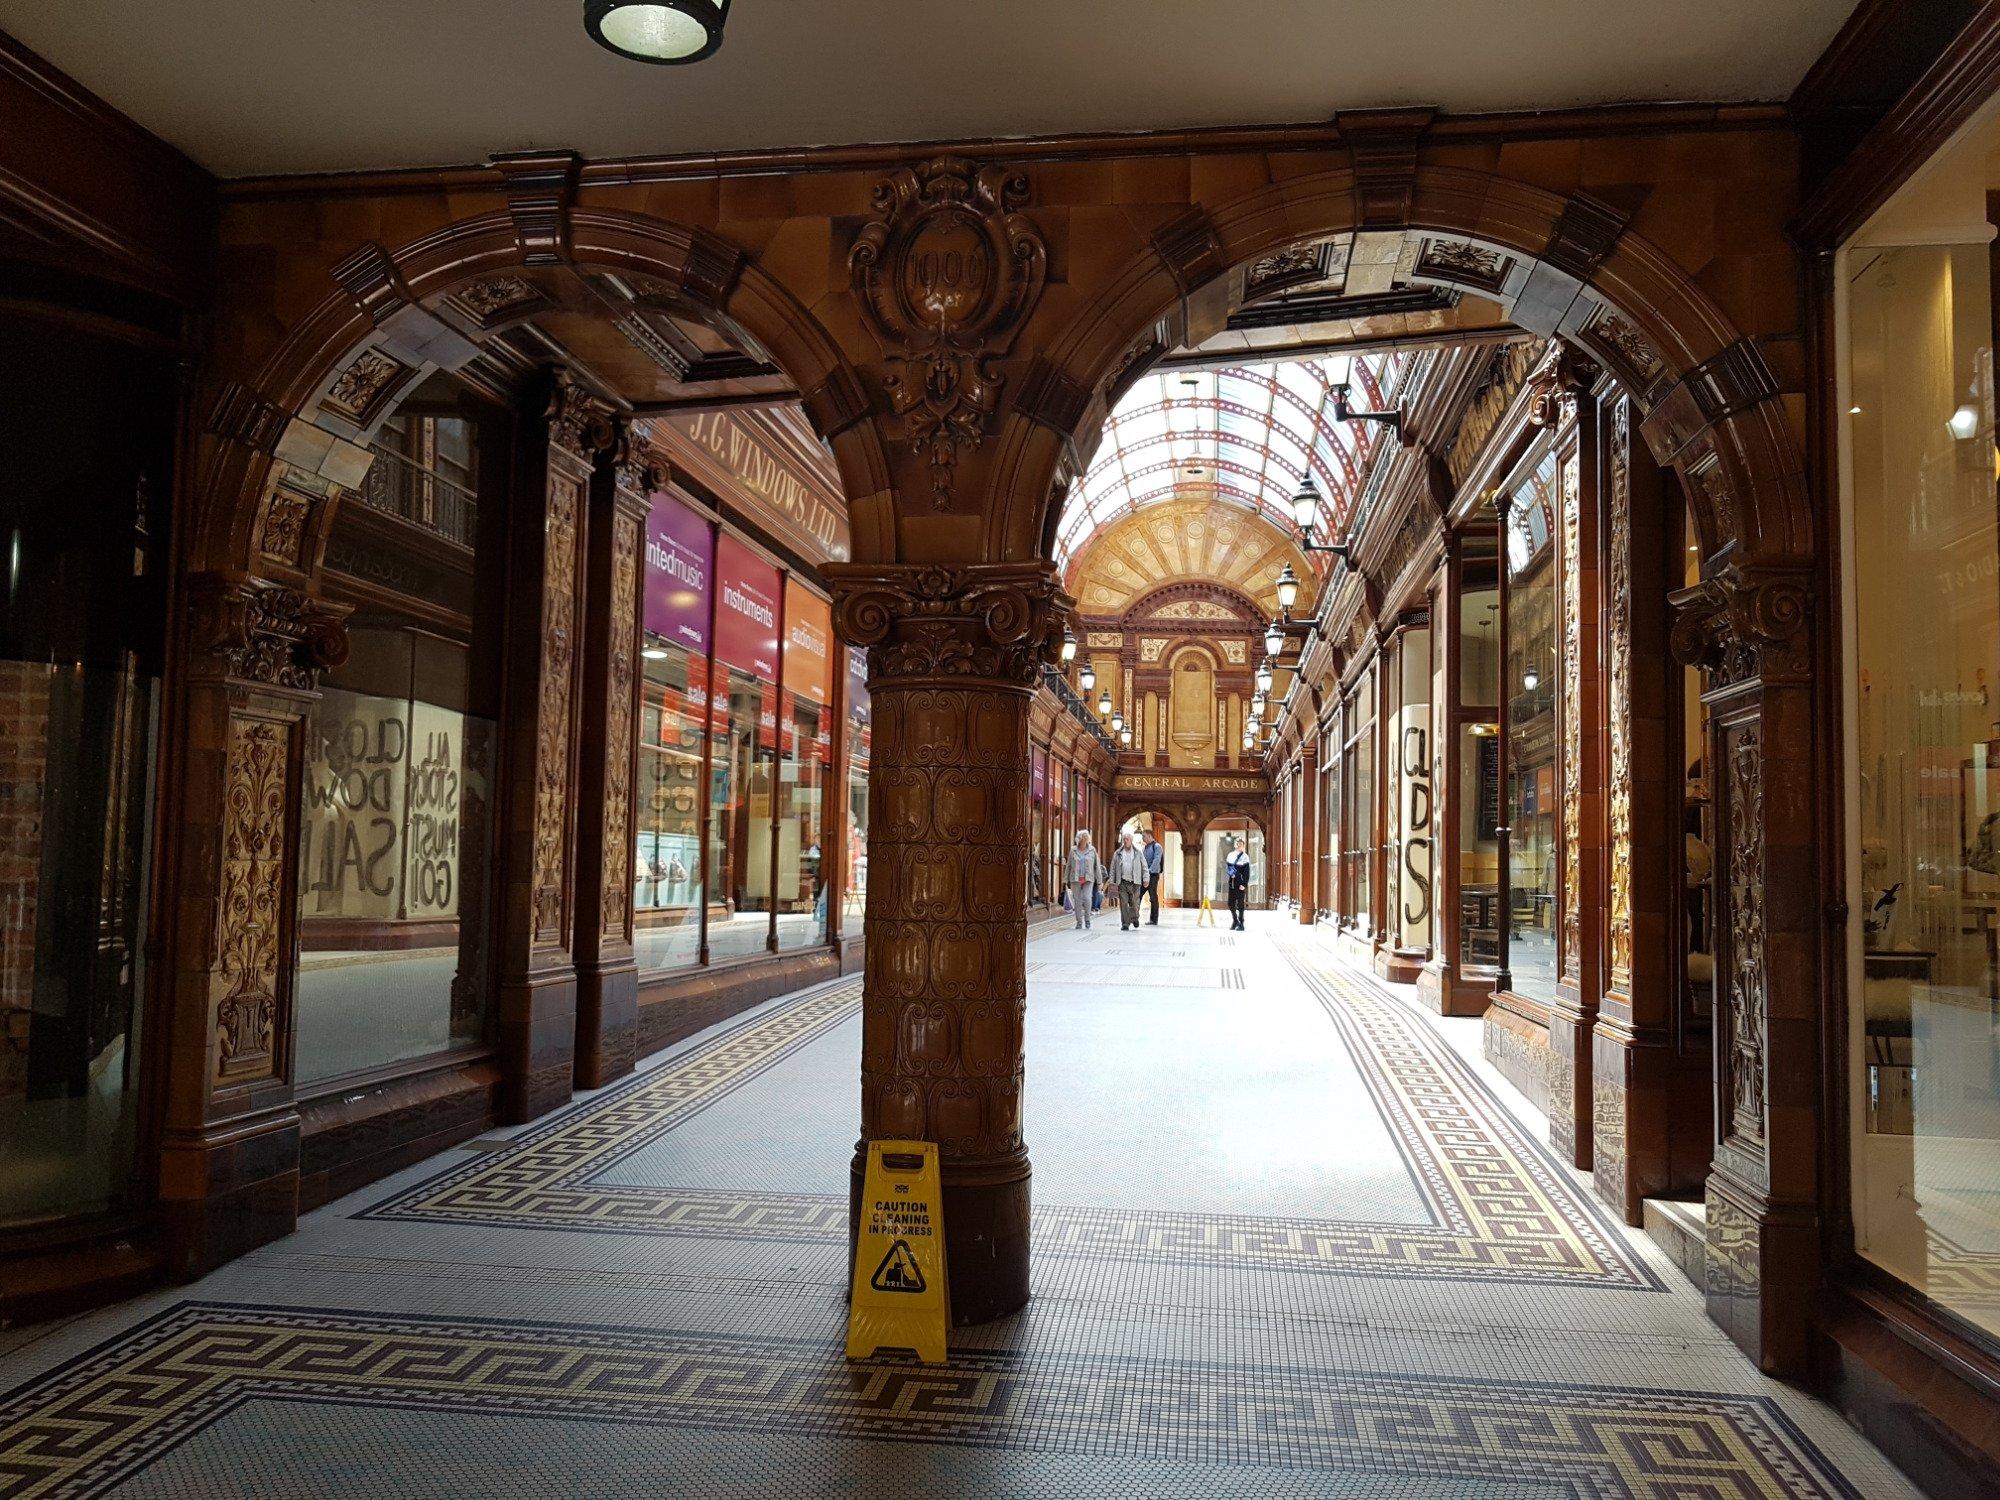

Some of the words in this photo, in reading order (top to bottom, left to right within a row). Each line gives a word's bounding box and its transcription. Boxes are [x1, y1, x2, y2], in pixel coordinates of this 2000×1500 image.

[724, 580, 774, 628] instruments
[1124, 777, 1190, 789] CENTRAL
[1202, 778, 1258, 789] ARCADE
[875, 1201, 928, 1213] CAUTION
[872, 1213, 930, 1225] CLEANING
[868, 1225, 879, 1234] IN
[881, 1225, 933, 1237] PROGRESS
